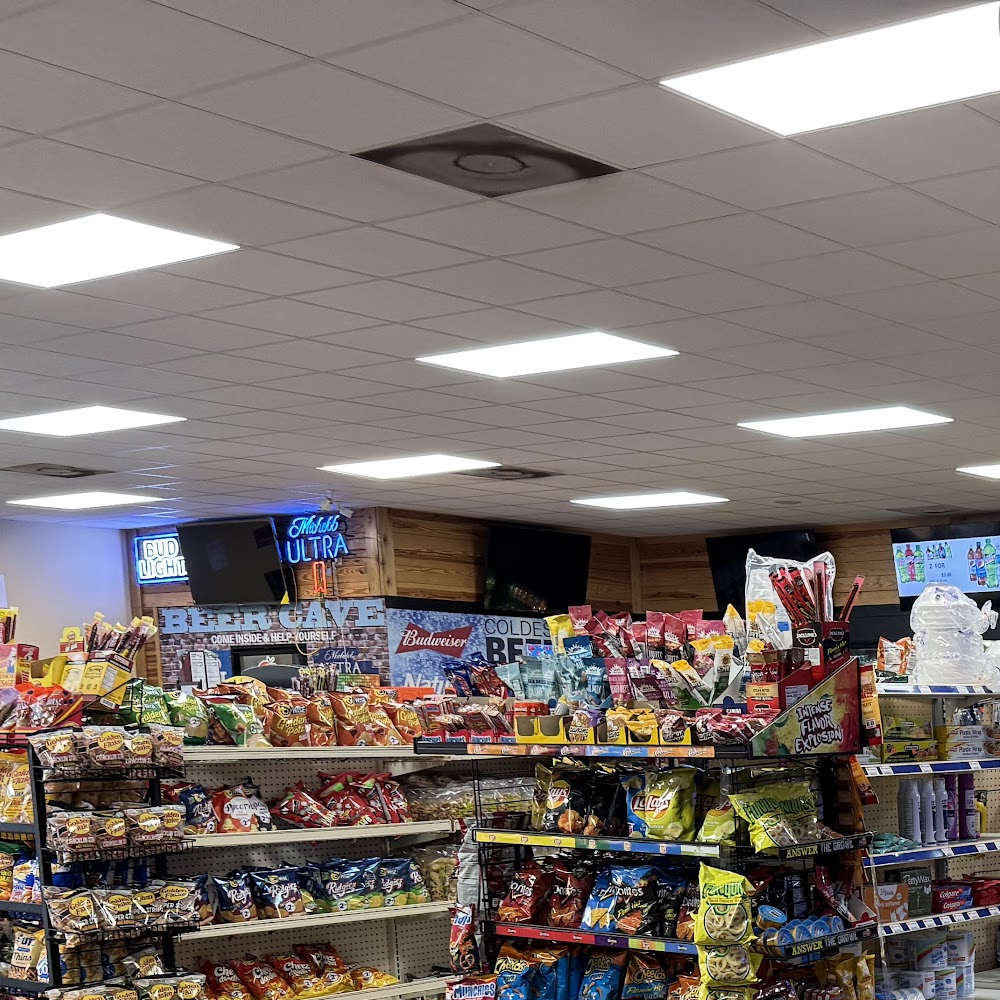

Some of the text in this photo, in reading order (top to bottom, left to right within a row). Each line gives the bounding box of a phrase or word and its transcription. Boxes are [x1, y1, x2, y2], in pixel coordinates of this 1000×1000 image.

[143, 538, 179, 559] BUD
[285, 533, 349, 564] ULTRA
[161, 599, 386, 634] BEER CAVE
[211, 630, 337, 644] COME INSIDE & HELP YOURSELF
[484, 618, 552, 637] COLDES
[402, 629, 468, 648] Budweiser
[291, 706, 307, 714] WISE
[796, 698, 833, 720] INTENSE
[277, 716, 307, 730] Golden
[801, 714, 834, 736] FLAVOR
[795, 726, 843, 753] EXPLOSION
[786, 839, 854, 859] ANSWER THE GROWL
[939, 890, 960, 899] Colgate
[942, 901, 961, 910] Colgate
[792, 933, 859, 956] ANSWER THE GROWL
[495, 957, 529, 975] Cheetos
[632, 967, 667, 984] Cheetos
